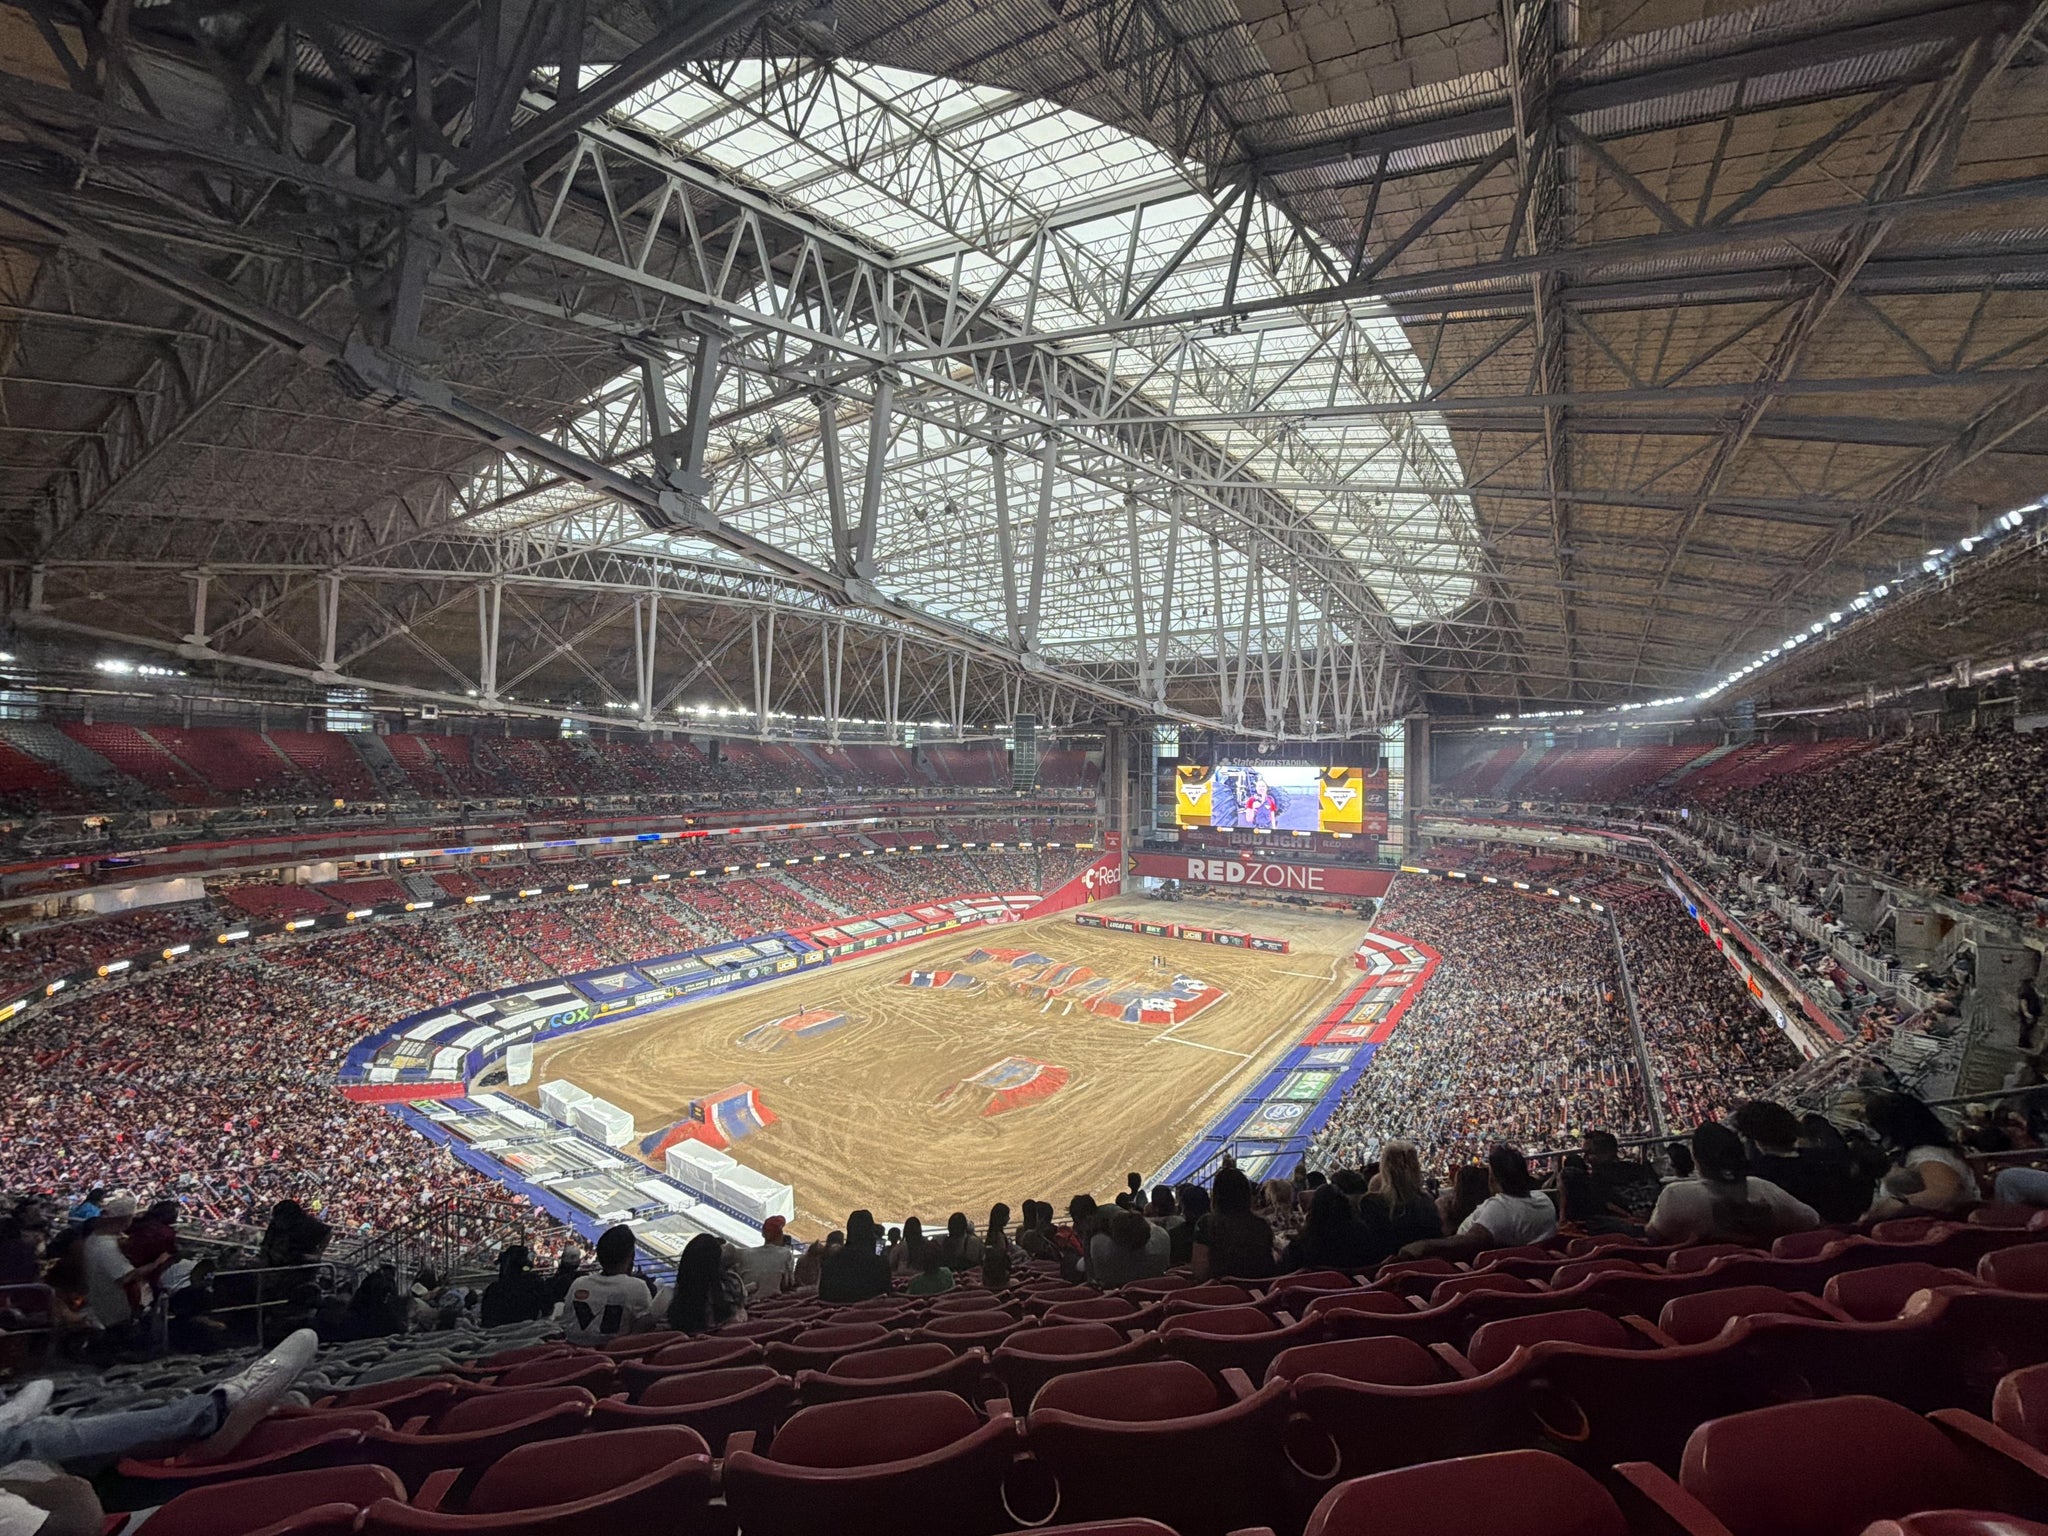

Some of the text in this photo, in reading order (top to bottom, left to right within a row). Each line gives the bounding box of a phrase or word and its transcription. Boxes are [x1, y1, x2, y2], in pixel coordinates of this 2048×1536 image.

[1231, 833, 1312, 848] BUD LIGHT
[1187, 858, 1325, 891] REDZONE
[649, 960, 702, 976] LUCAS OIL
[709, 974, 731, 986] LUCAS
[549, 1007, 590, 1029] COX
